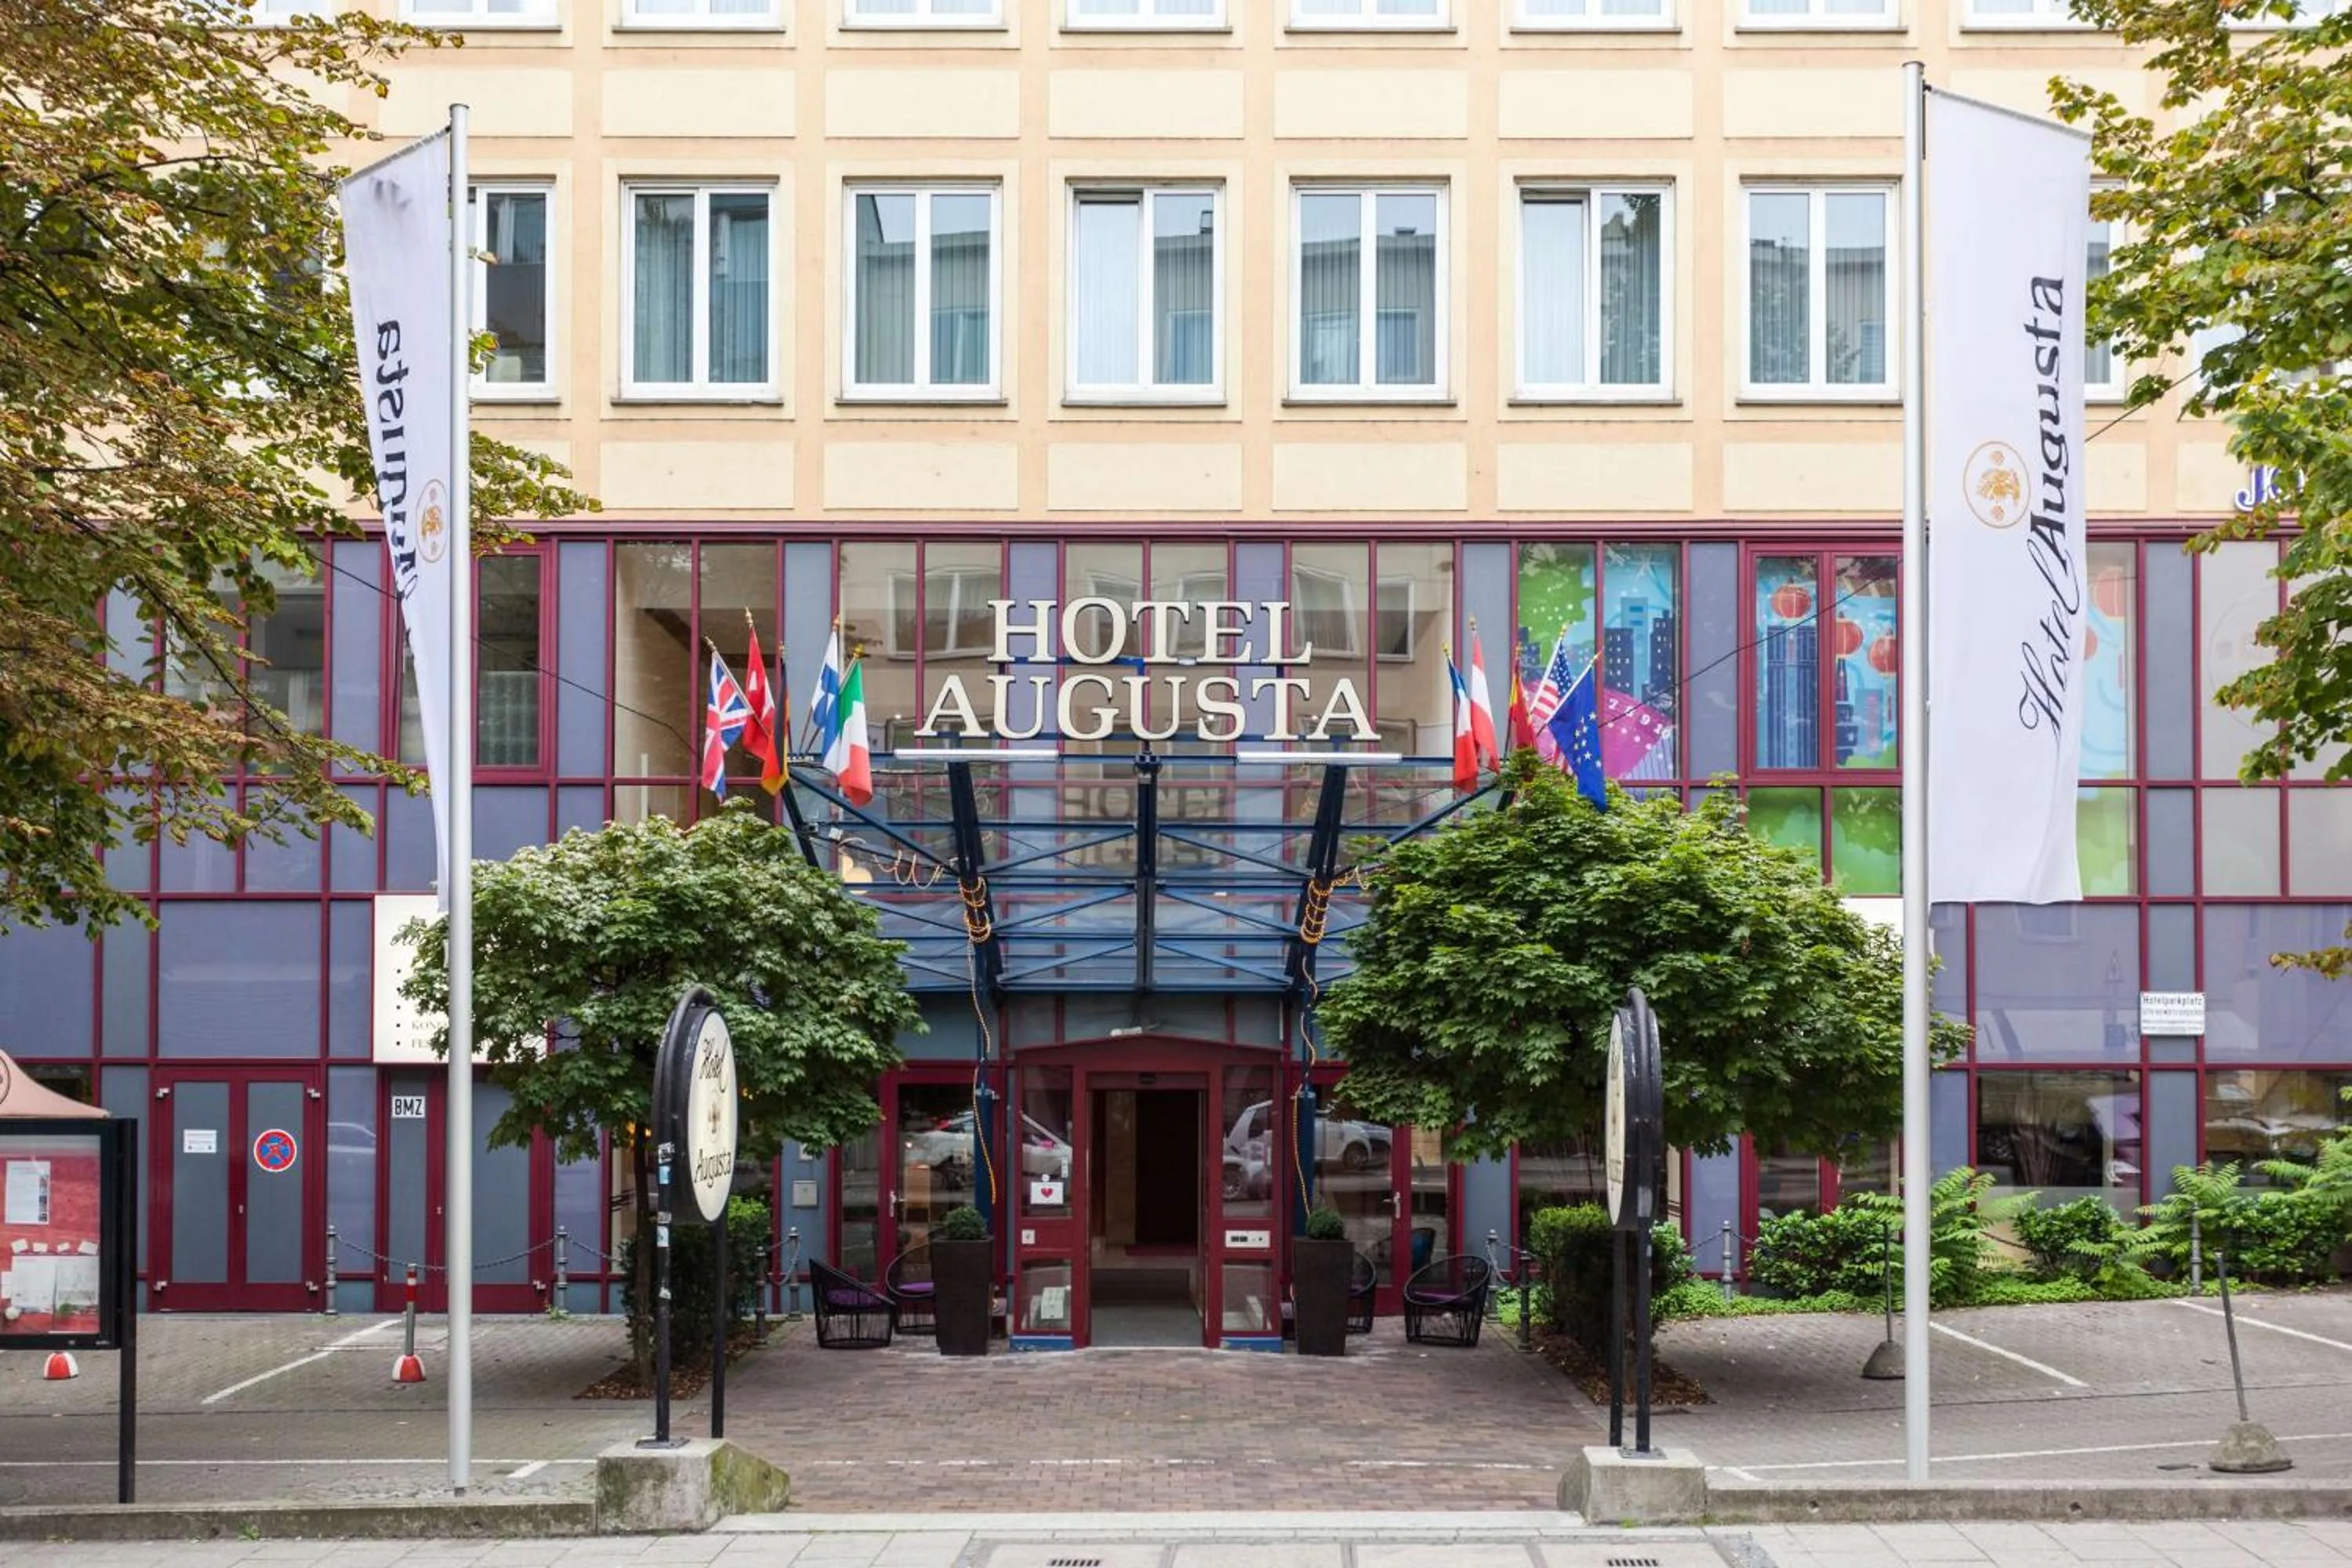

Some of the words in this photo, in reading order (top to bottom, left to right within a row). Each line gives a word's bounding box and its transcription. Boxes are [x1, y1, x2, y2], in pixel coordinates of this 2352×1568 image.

[2024, 275, 2070, 576] Augusta
[985, 597, 1313, 665] HOTEL
[2020, 539, 2079, 737] Hotel
[913, 673, 1382, 742] AUGUSTA
[1640, 713, 1650, 725] 9
[699, 1037, 728, 1093] Hotel
[394, 1098, 423, 1116] BMZ
[694, 1149, 732, 1189] Augusta
